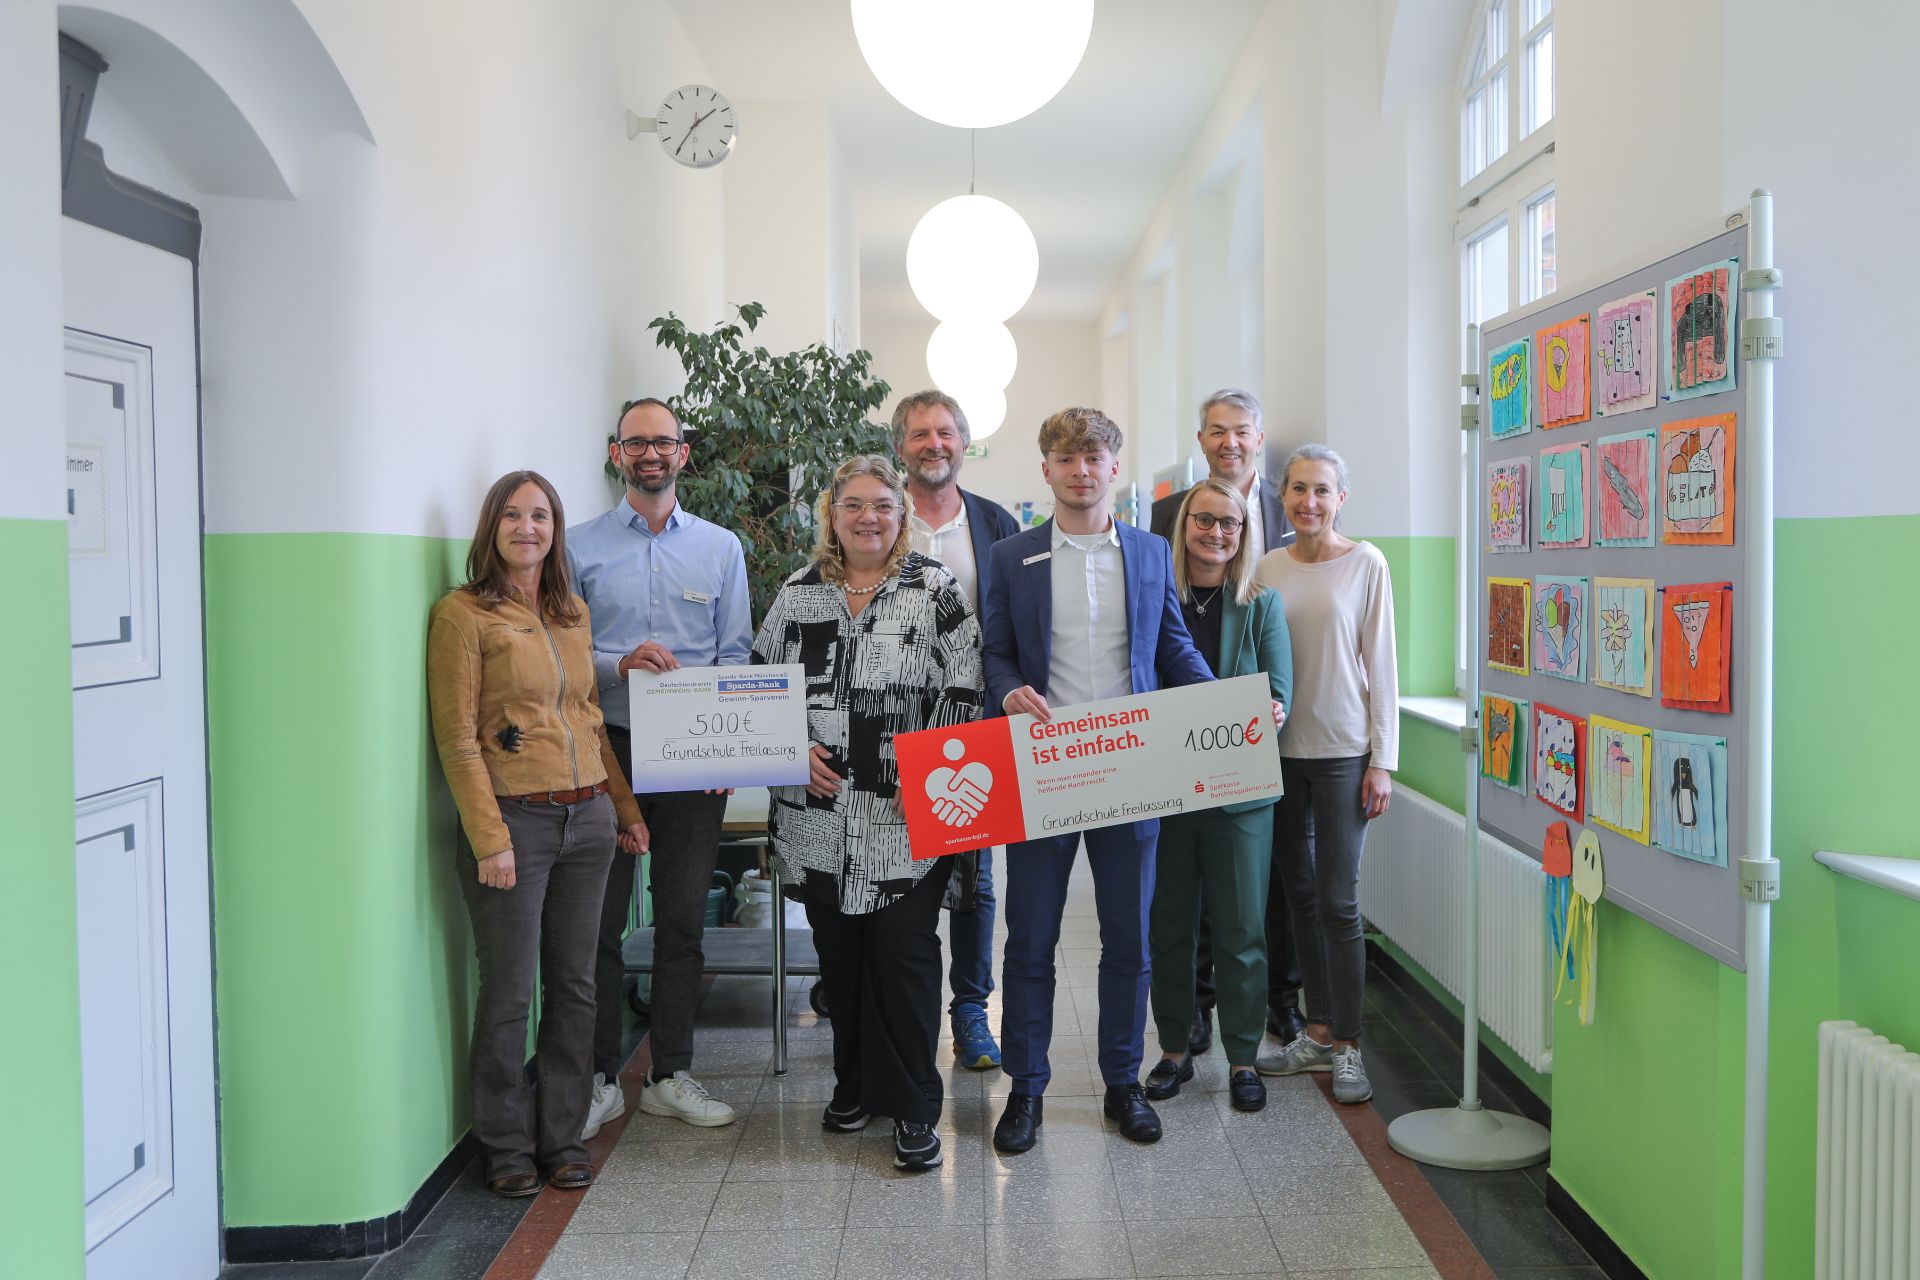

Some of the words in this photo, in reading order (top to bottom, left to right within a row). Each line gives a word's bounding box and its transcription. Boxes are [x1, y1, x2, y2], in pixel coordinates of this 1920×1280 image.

[66, 455, 94, 472] immer
[726, 681, 780, 690] Sparda-Bank
[718, 693, 790, 703] Gewinn-Sparverein
[688, 710, 755, 736] 500€
[1029, 708, 1150, 740] Gemeinsam
[662, 743, 736, 760] Grundschule
[740, 740, 796, 761] Freilassing
[1032, 745, 1061, 765] ist
[1065, 730, 1145, 758] einfach.
[1036, 778, 1056, 786] Wenn
[1072, 770, 1101, 779] einander
[1209, 781, 1240, 791] Sparkasse
[1037, 784, 1067, 795] helfende
[1068, 780, 1086, 788] Hand
[1210, 785, 1262, 799] Berchtesgadener
[1262, 782, 1278, 790] Land
[1042, 806, 1119, 830] Grundschule
[1121, 798, 1183, 812] Freilassing
